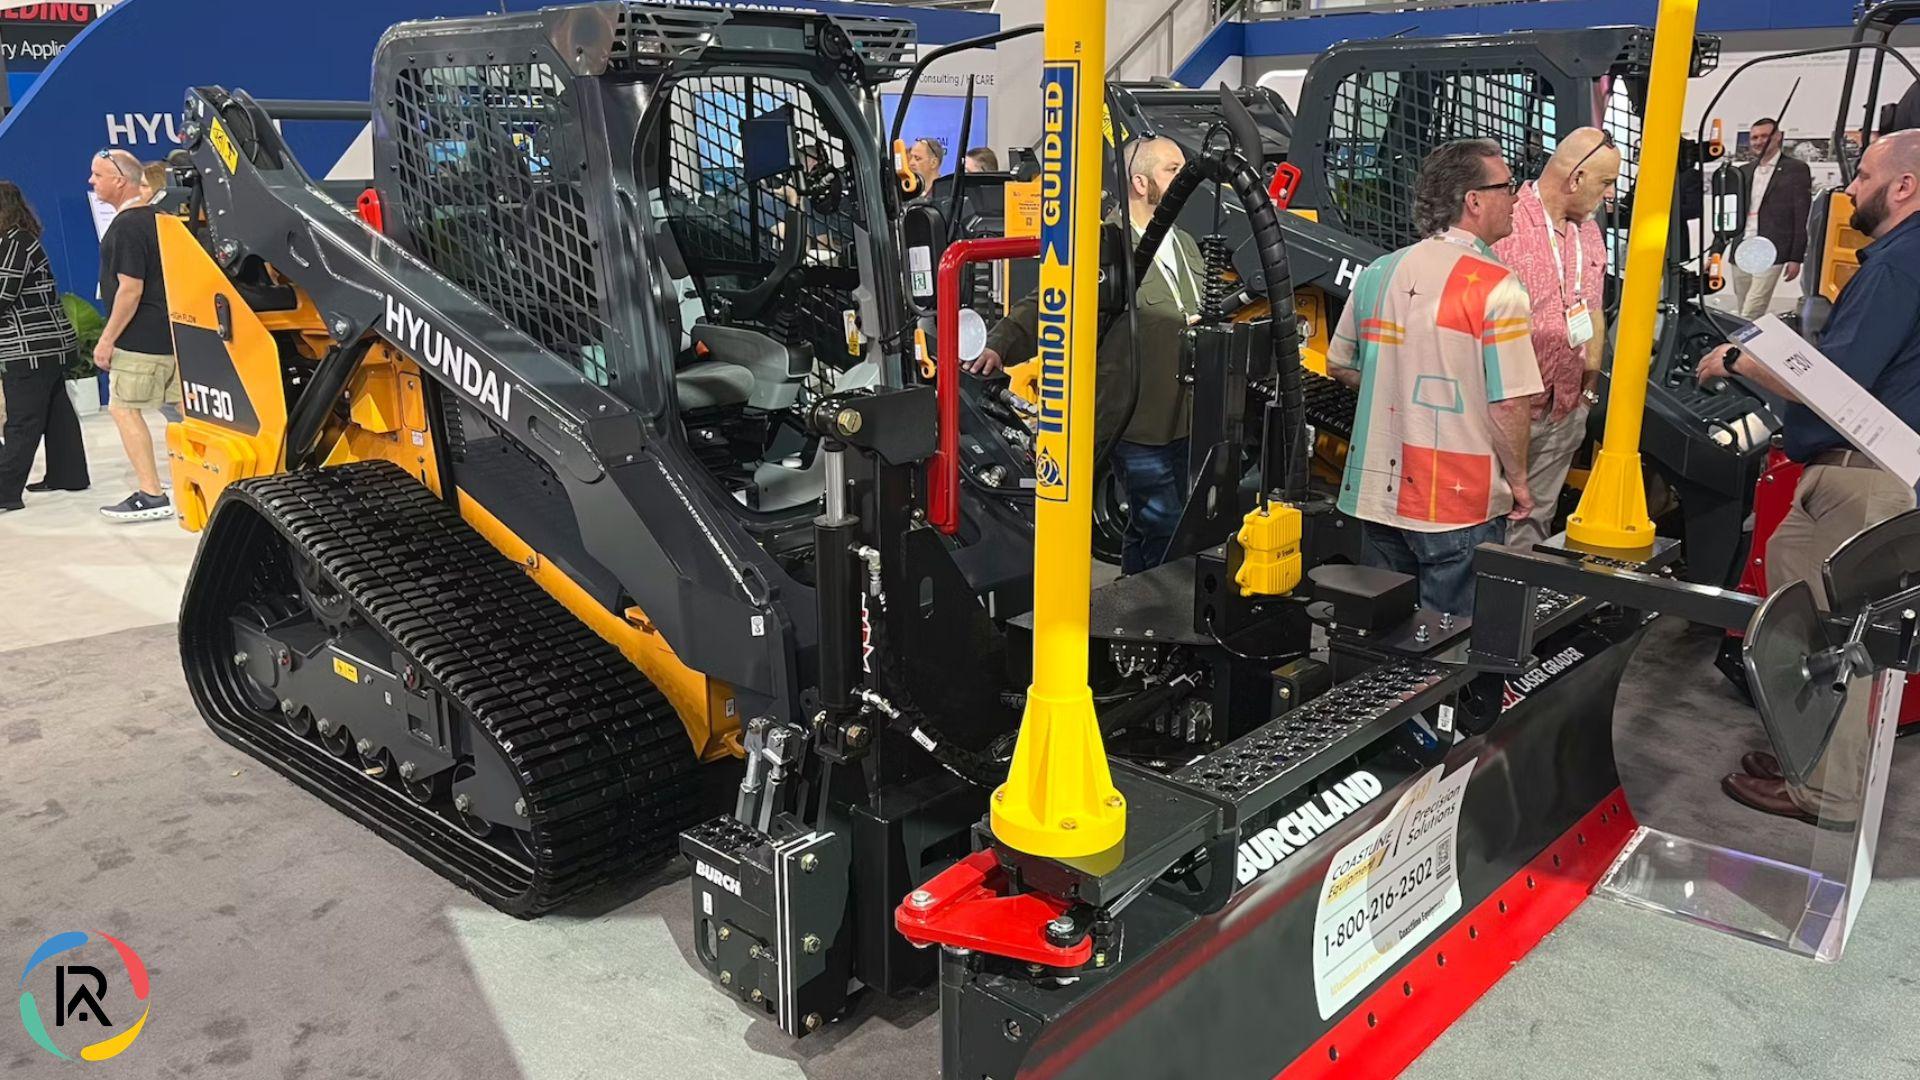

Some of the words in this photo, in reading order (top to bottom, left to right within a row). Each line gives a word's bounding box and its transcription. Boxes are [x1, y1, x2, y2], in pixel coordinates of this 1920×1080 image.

[919, 73, 960, 86] Consulting
[1043, 81, 1064, 226] GUIDED
[386, 294, 512, 422] HYUNDAI
[183, 380, 234, 422] HT30
[1513, 668, 1551, 693] LASER
[1541, 646, 1585, 675] GRADER
[1236, 770, 1383, 886] BURCHLAND
[1406, 803, 1456, 846] Solutions
[1411, 785, 1461, 827] Precision
[696, 859, 742, 897] BURCH
[1332, 829, 1394, 881] COASTLINE
[1324, 856, 1433, 957] 1-800-216-2502
